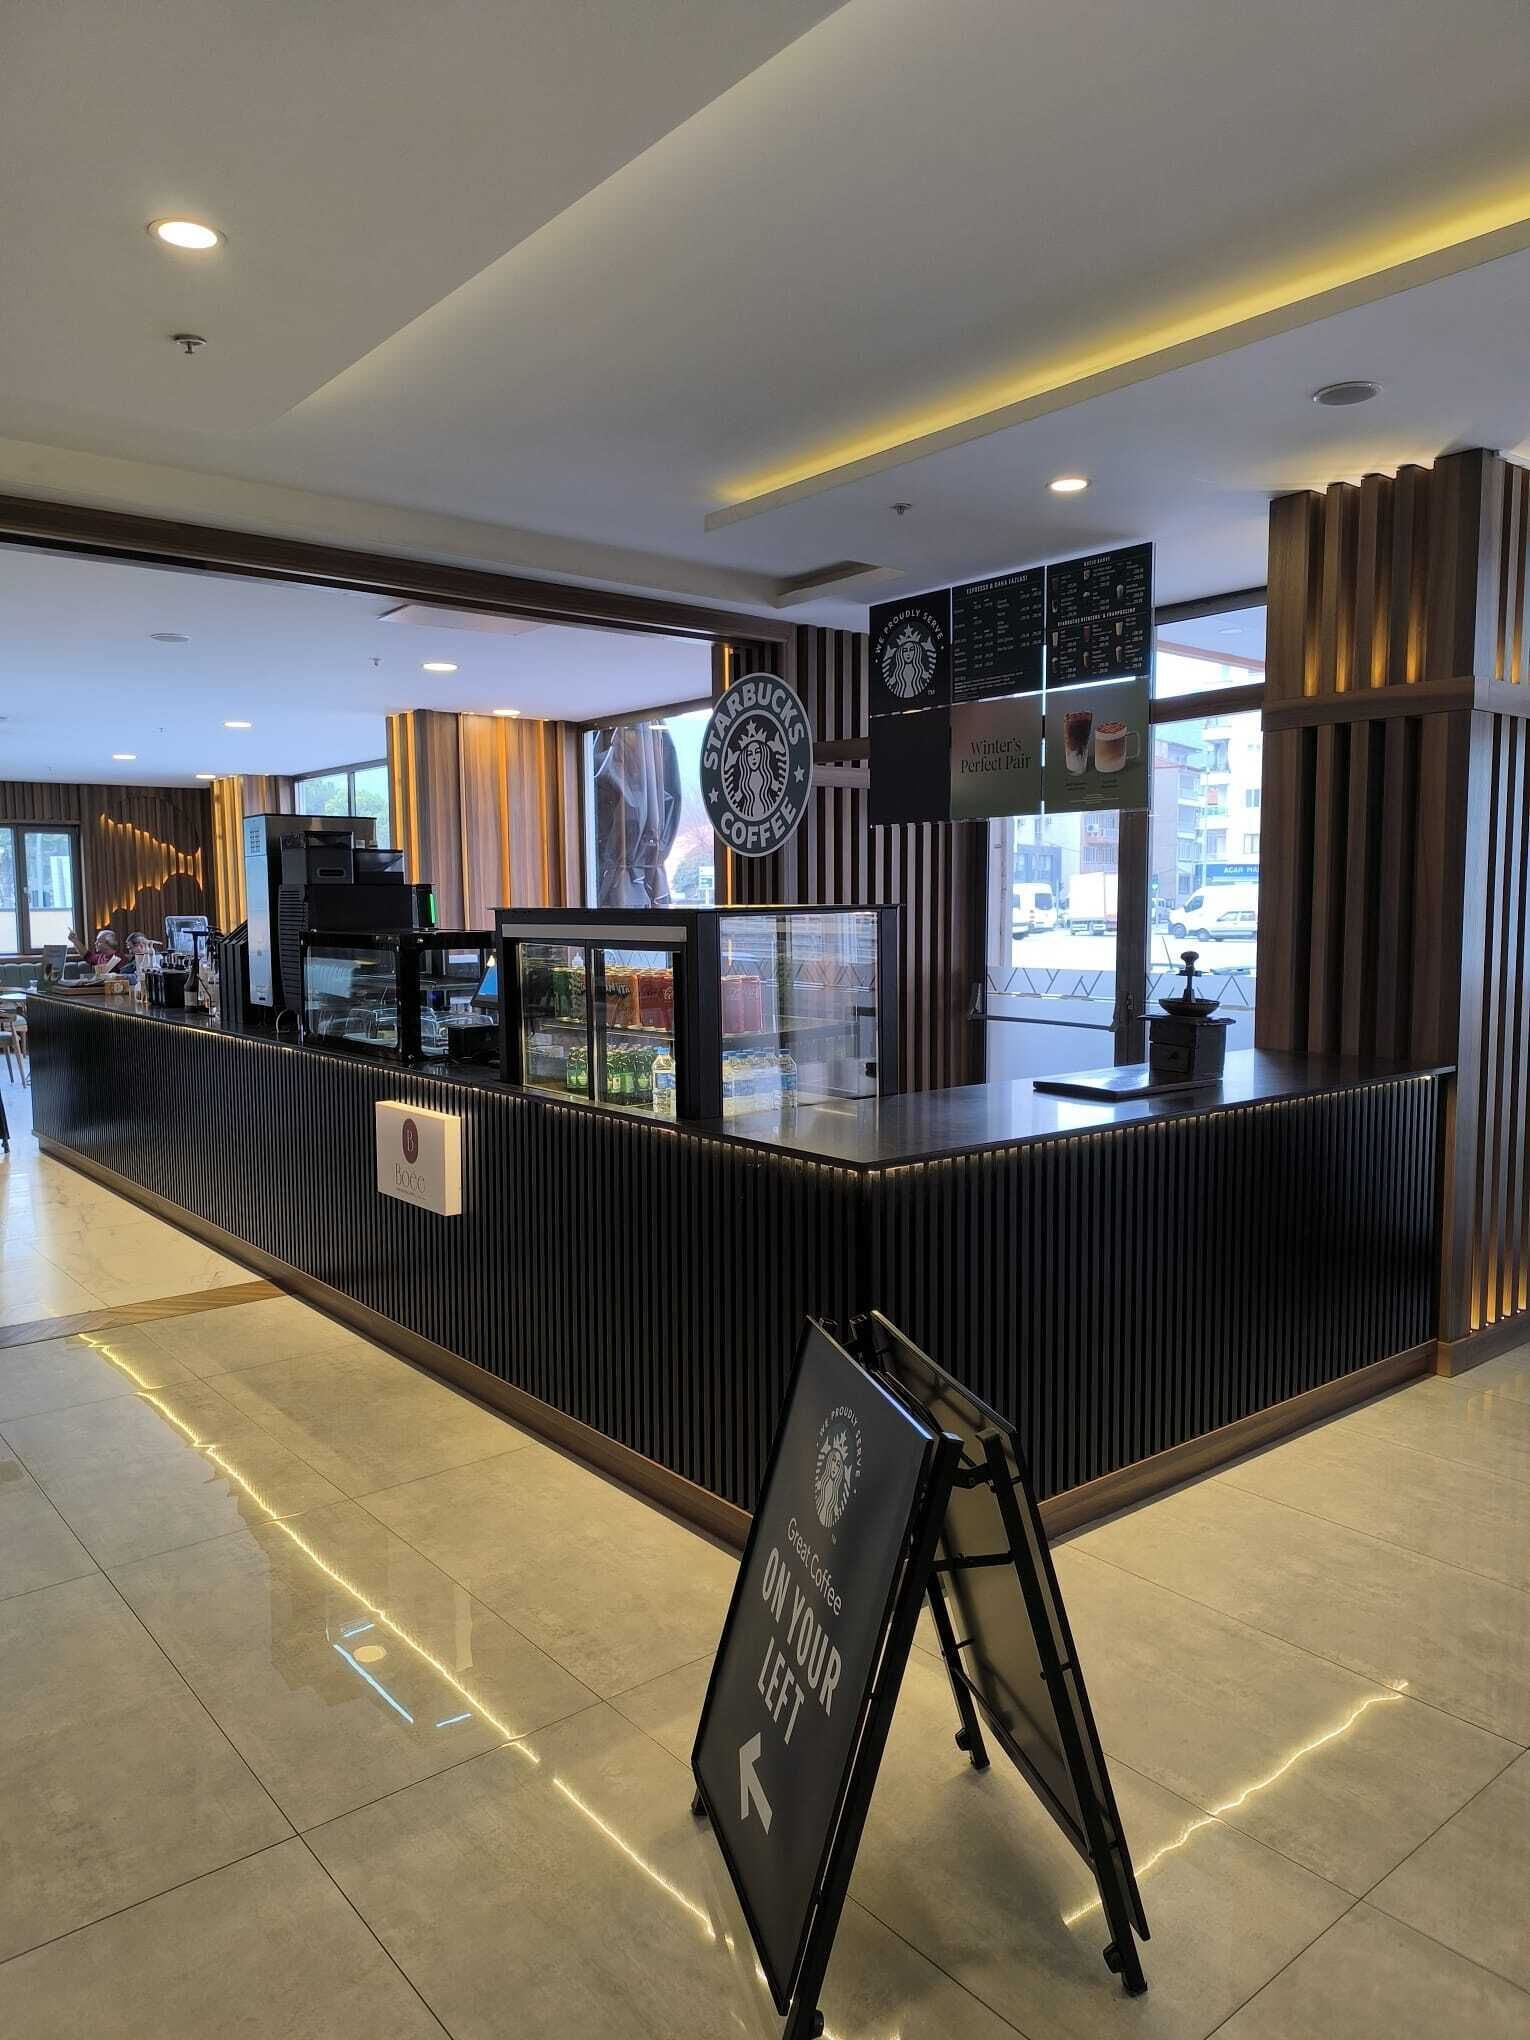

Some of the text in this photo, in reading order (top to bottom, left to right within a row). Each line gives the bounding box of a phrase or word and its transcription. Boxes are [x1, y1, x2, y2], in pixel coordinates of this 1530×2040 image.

[884, 609, 921, 634] PROUDLY
[922, 612, 944, 640] SERVE
[704, 682, 804, 770] STARBUCKS
[970, 736, 1022, 754] Winter's
[961, 753, 1032, 775] Perfect Pair
[720, 797, 797, 849] COFFEE
[831, 1406, 858, 1427] PROUDLY
[788, 1517, 842, 1616] Great Coffee
[762, 1547, 842, 1717] ON YOUR
[757, 1636, 805, 1745] LEFT
